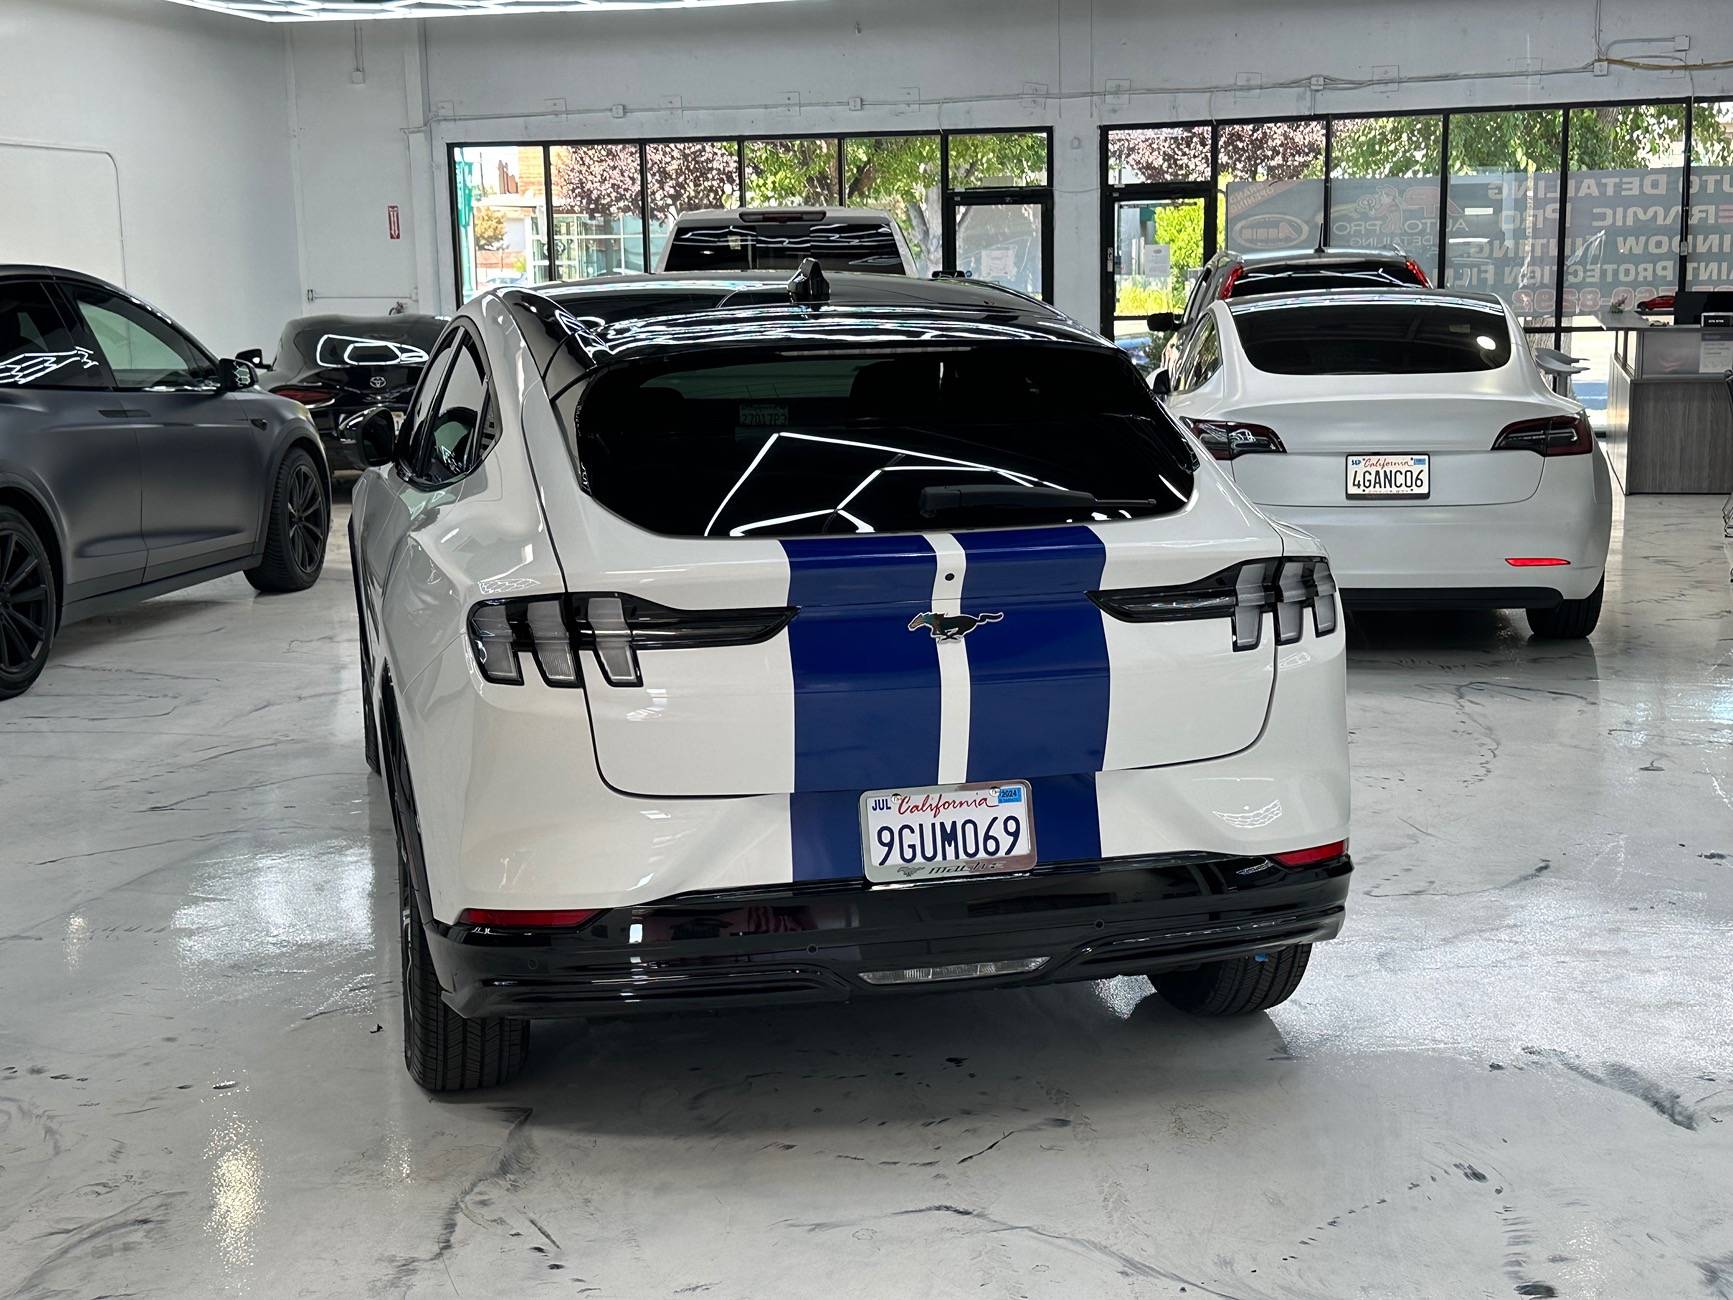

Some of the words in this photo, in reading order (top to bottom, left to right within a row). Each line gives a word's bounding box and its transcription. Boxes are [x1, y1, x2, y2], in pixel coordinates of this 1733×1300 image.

[1363, 457, 1413, 470] California
[871, 798, 892, 812] JUL
[897, 793, 999, 818] California
[1001, 790, 1018, 798] 2024
[876, 815, 1021, 866] 9GUM069
